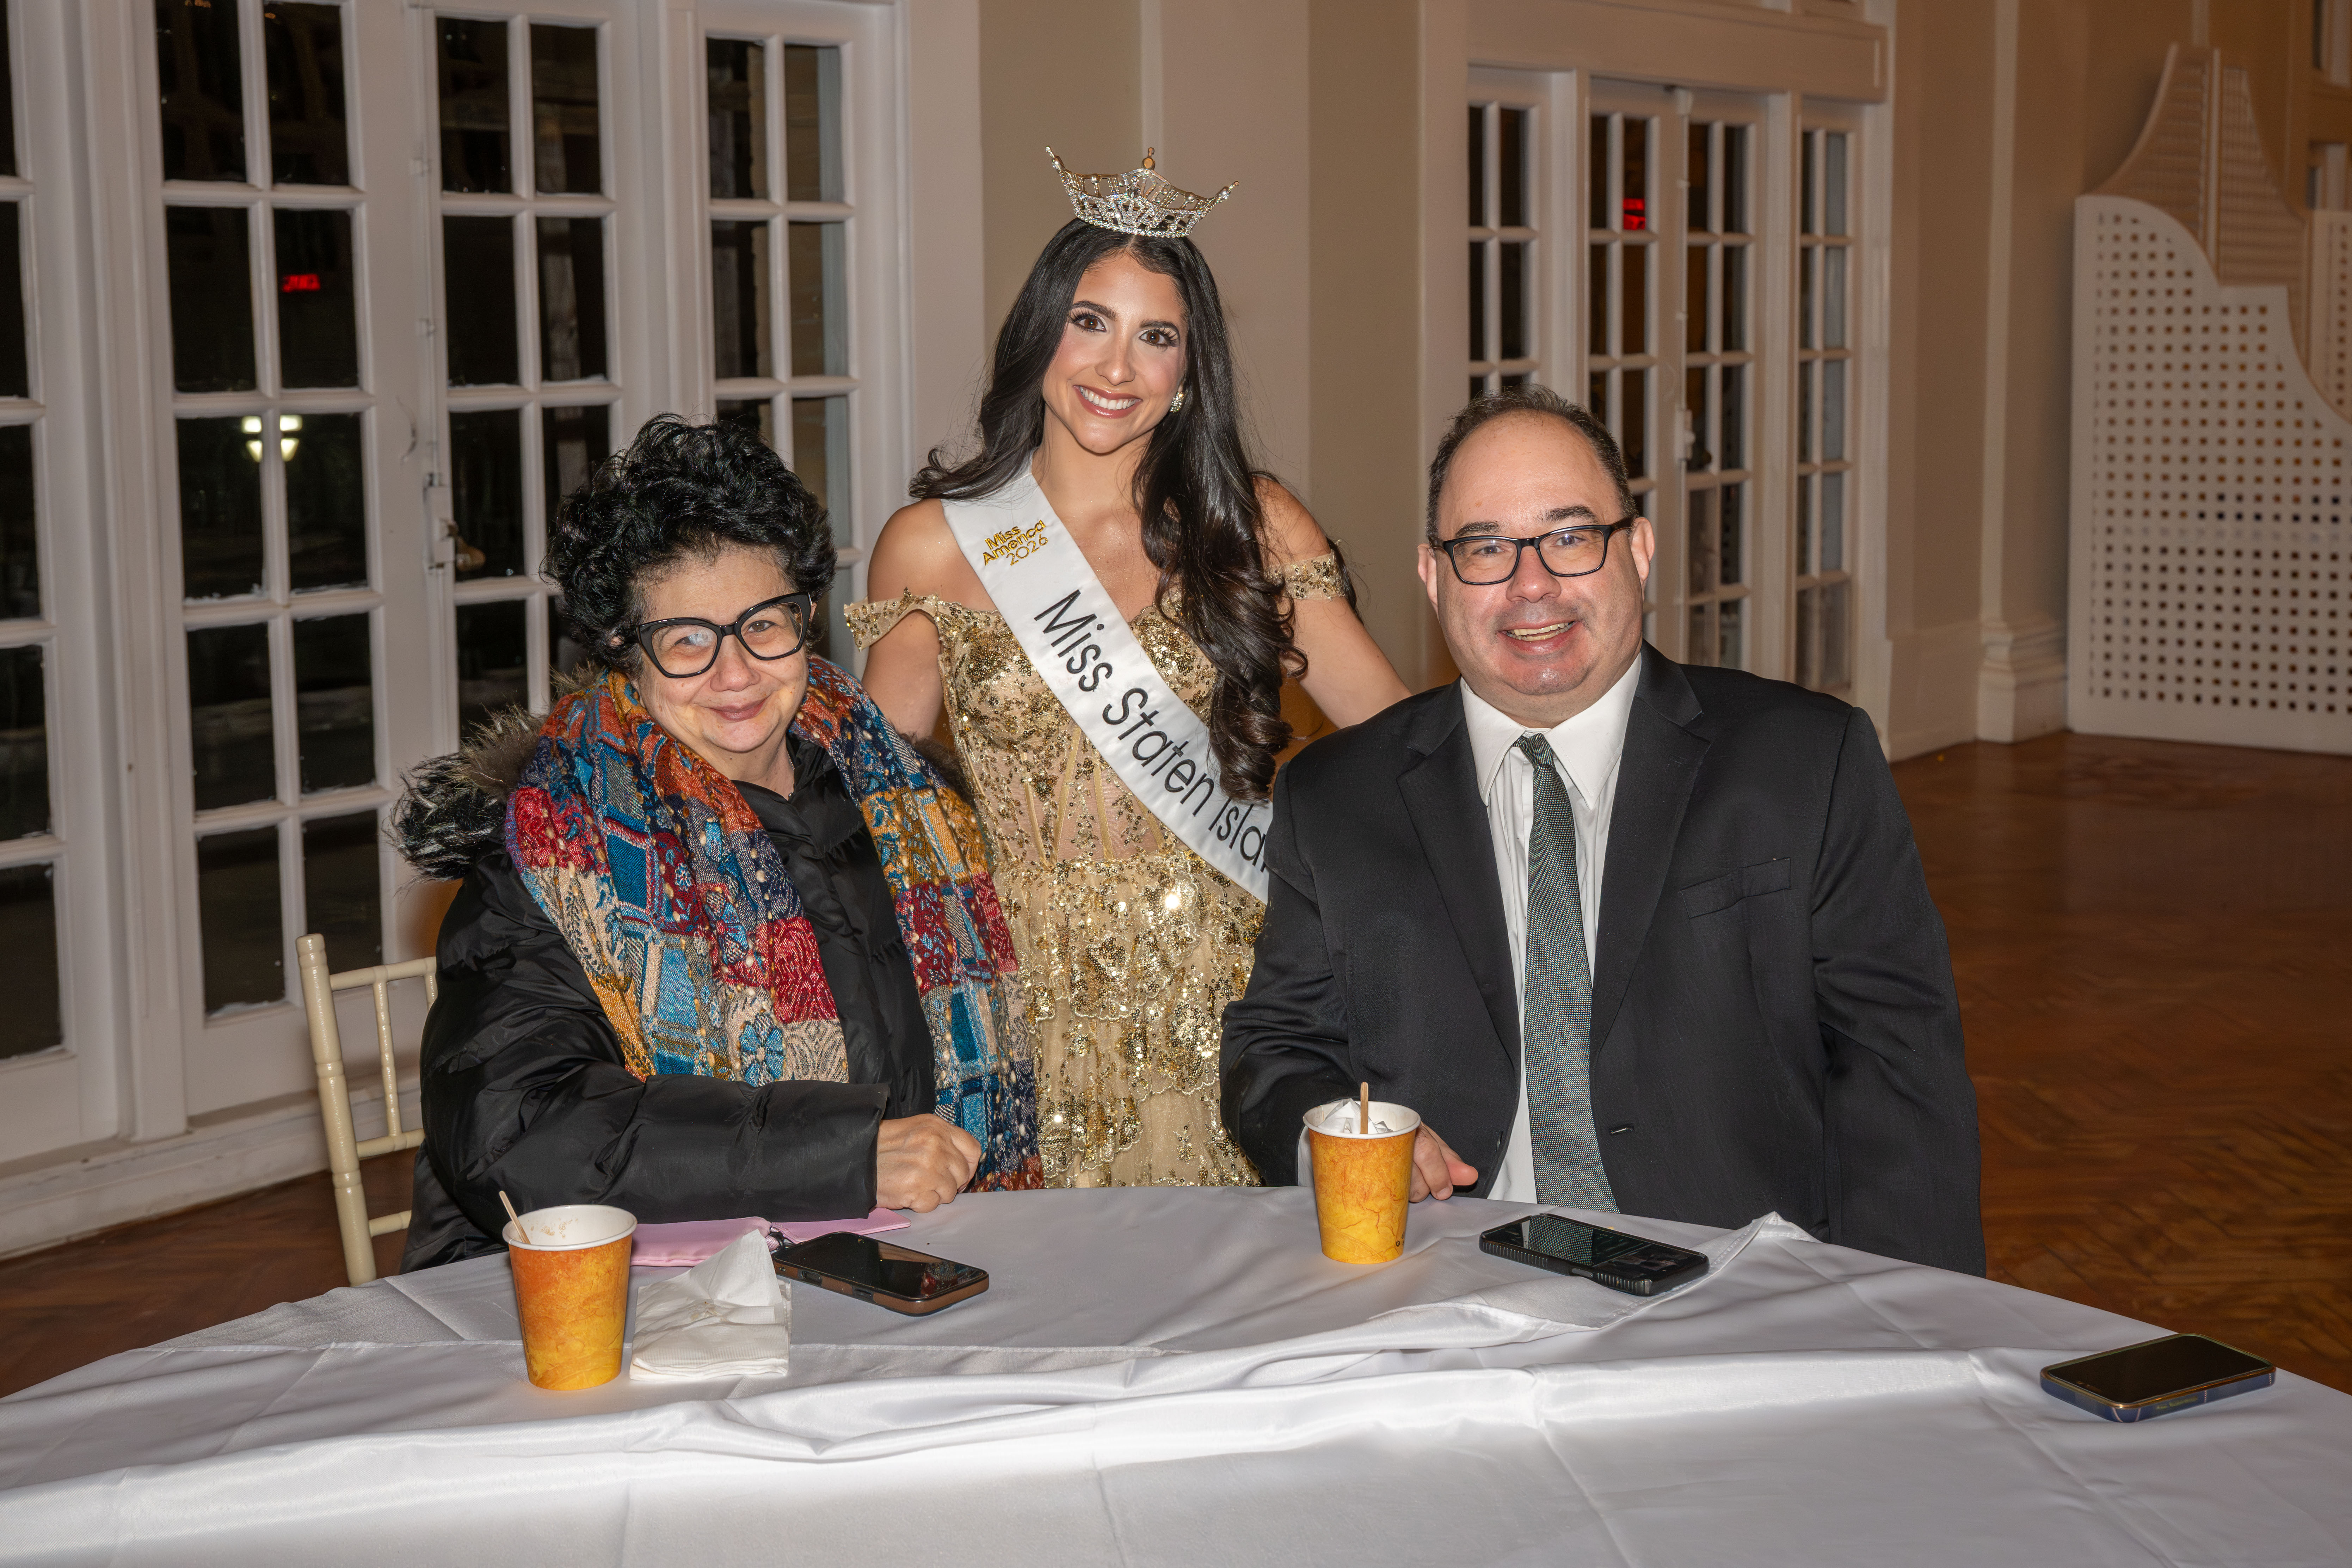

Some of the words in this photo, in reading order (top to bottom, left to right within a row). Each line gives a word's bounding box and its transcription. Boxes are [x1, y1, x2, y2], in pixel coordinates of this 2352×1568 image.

[983, 519, 1046, 566] America
[985, 526, 1021, 550] Miss
[1006, 534, 1048, 566] 2026
[1034, 589, 1113, 691] Miss
[1102, 688, 1214, 817] Staten
[1208, 797, 1267, 873] Isla
